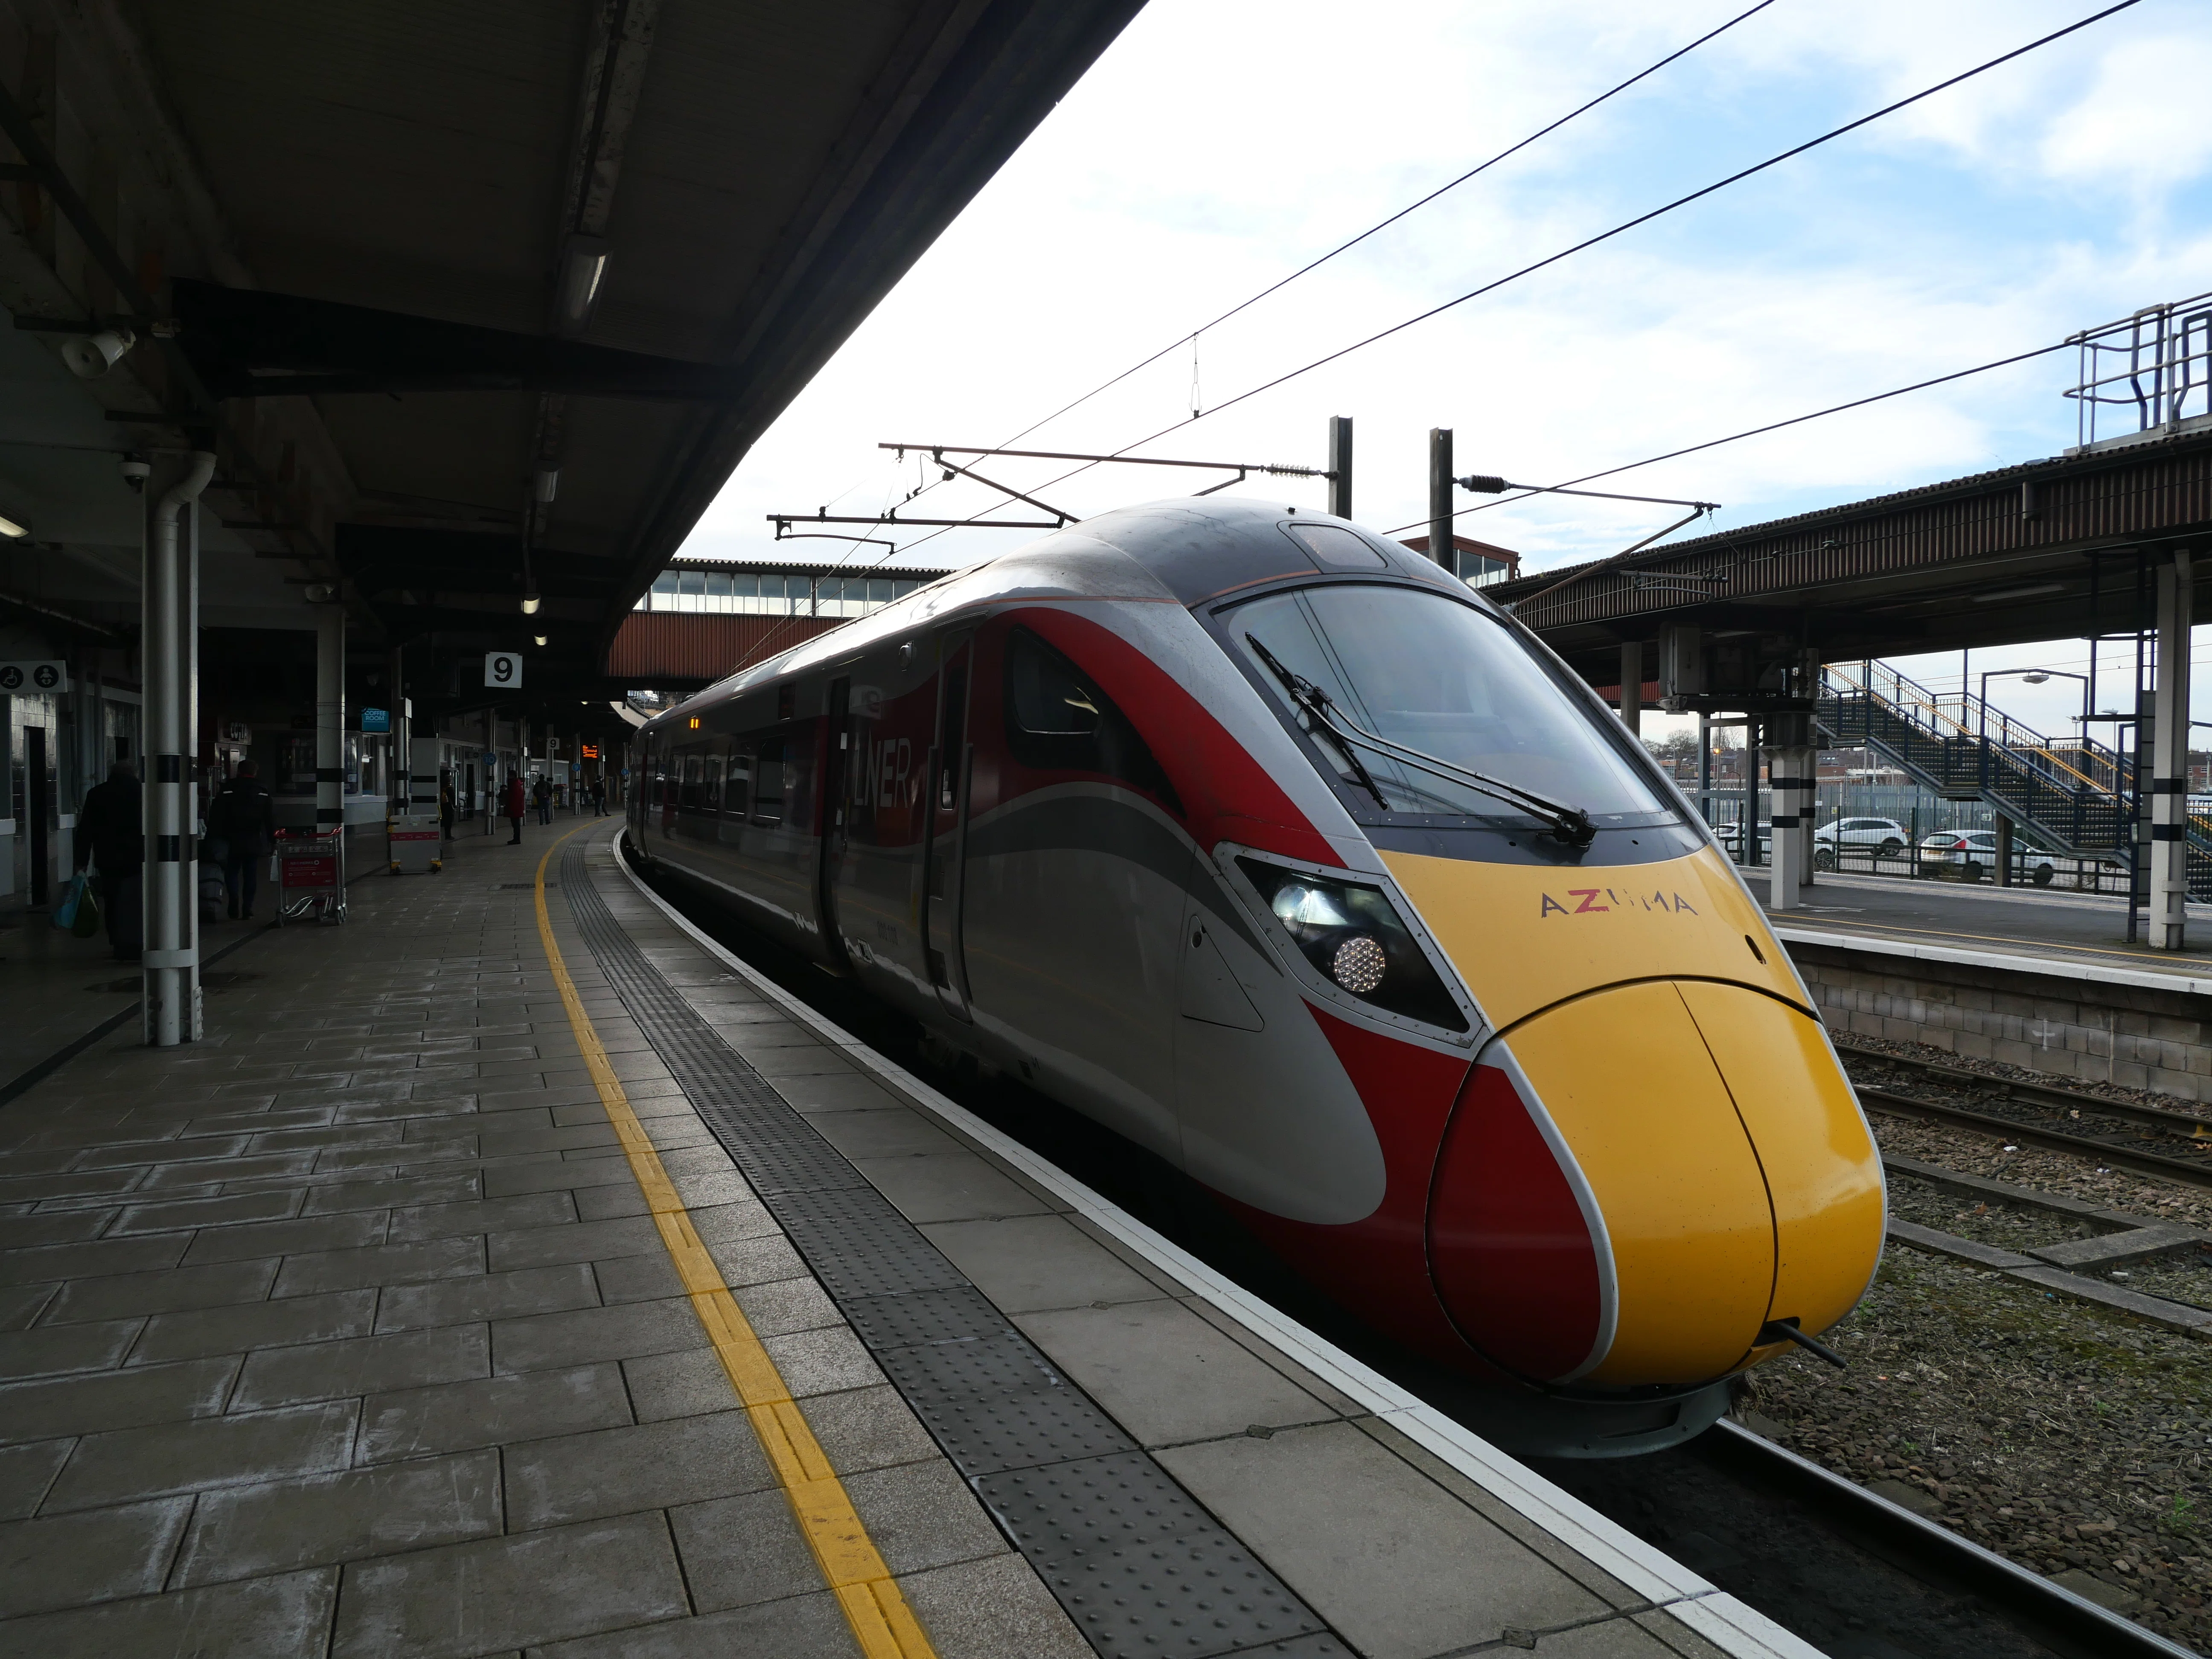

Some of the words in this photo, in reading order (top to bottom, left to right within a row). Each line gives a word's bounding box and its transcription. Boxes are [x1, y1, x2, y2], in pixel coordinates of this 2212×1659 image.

[494, 657, 512, 682] 9
[550, 739, 556, 748] 9
[854, 727, 911, 822] LNER
